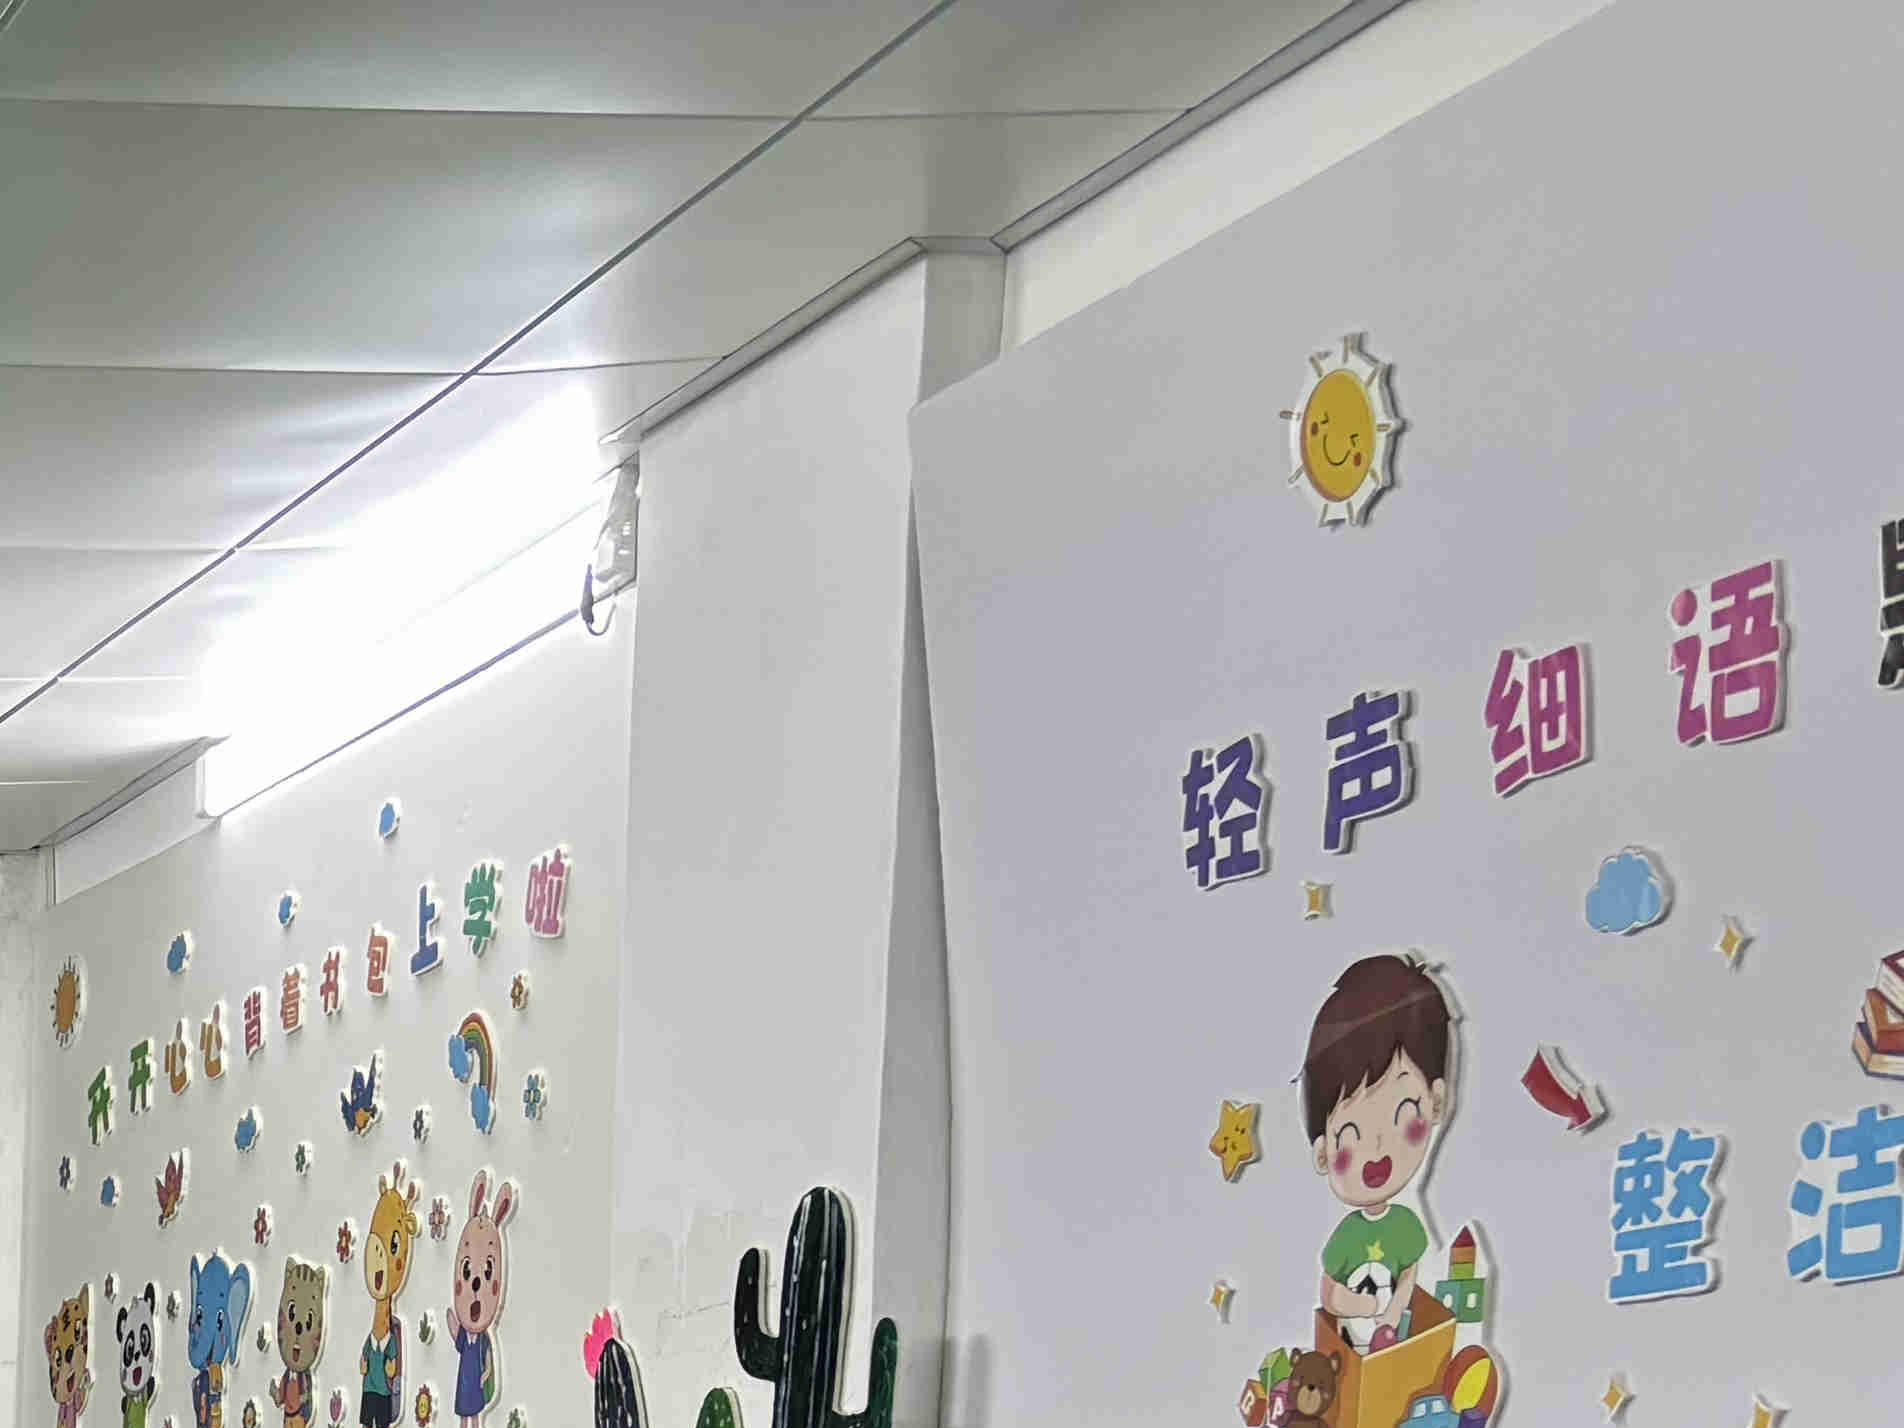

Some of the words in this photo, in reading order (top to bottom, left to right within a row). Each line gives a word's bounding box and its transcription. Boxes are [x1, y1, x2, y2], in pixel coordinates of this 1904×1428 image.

[87, 846, 567, 1146] 开开心心背着书包上学啦
